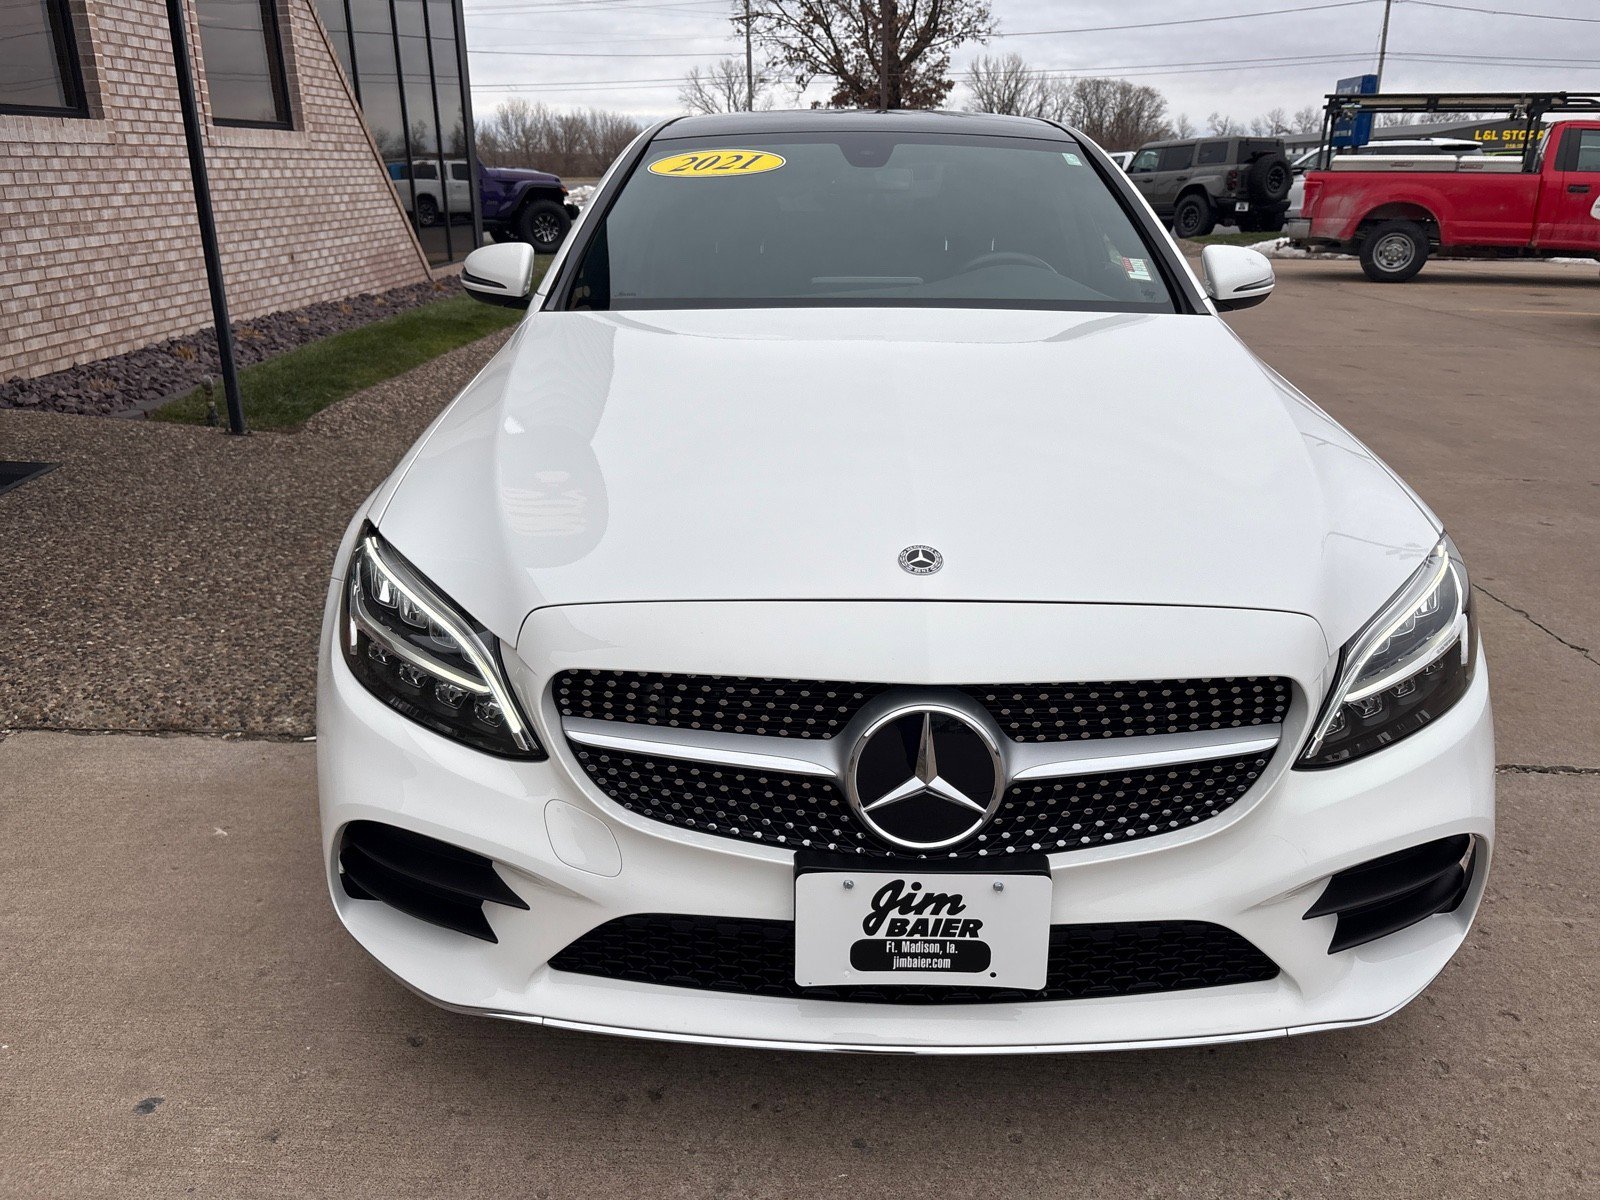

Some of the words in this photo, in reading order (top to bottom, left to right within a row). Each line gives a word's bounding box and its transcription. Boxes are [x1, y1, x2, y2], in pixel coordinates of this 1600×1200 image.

[1474, 129, 1499, 141] L&L
[668, 154, 764, 173] 2021
[862, 879, 967, 937] Jim
[885, 918, 984, 938] BAIER
[886, 941, 898, 954] Ft.
[901, 940, 943, 955] Madison,
[946, 941, 958, 954] Ia.
[892, 955, 951, 970] jimbaier.com
